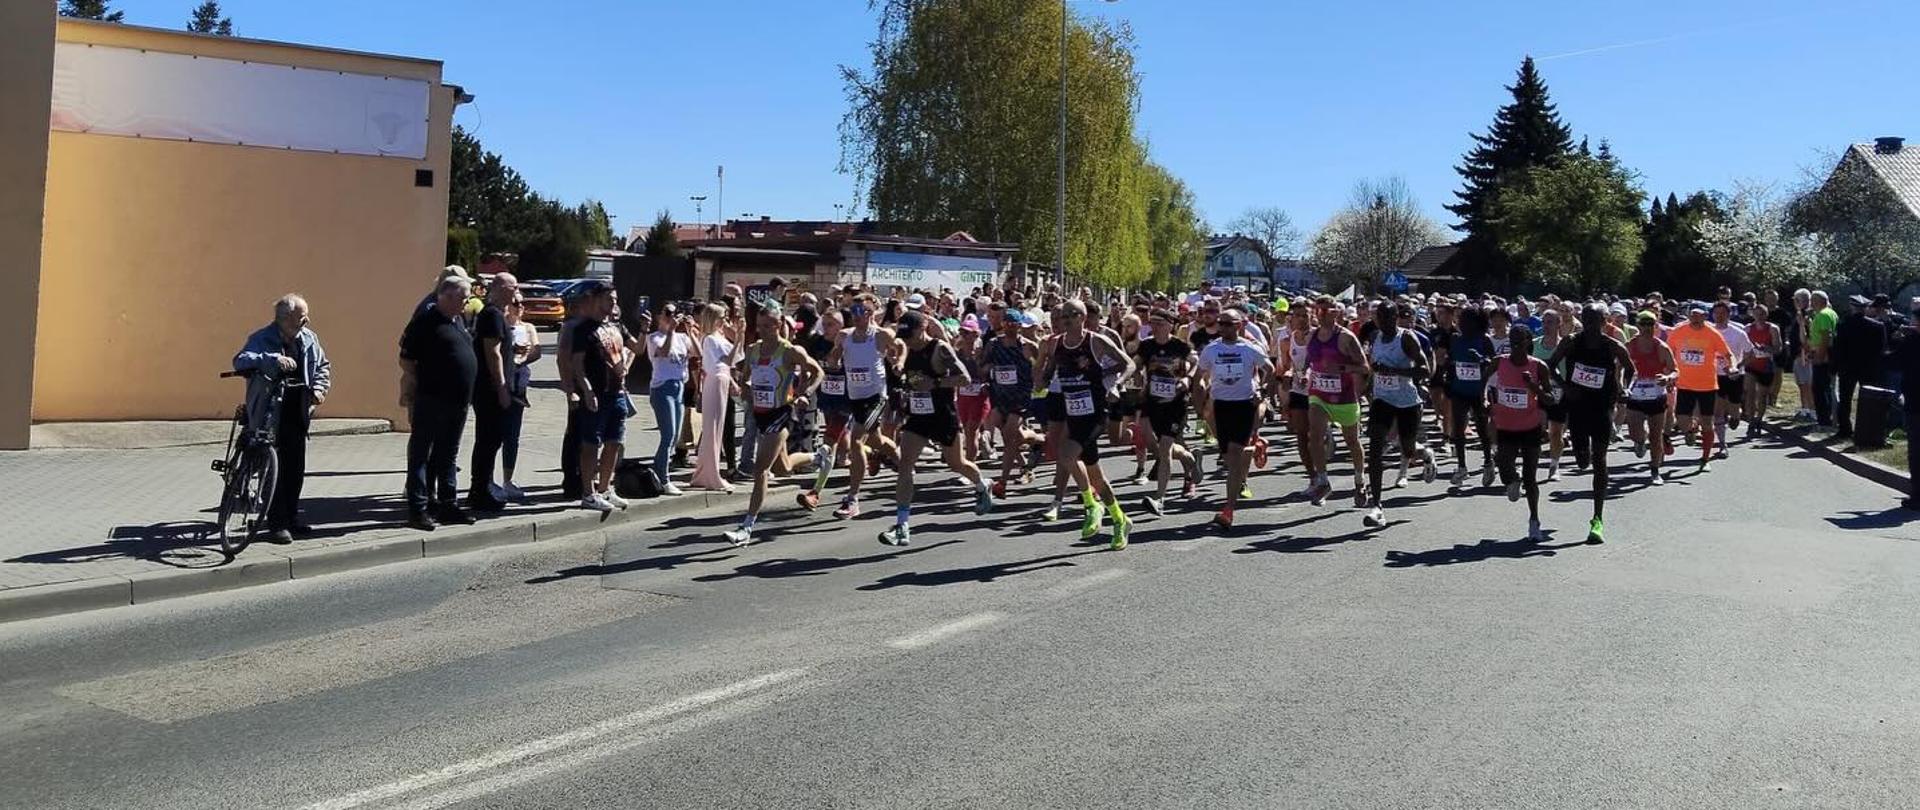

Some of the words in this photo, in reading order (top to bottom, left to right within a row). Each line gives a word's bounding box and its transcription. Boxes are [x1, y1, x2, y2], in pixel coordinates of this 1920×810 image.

[959, 272, 993, 283] GINTER
[1578, 372, 1599, 383] 164
[1069, 400, 1087, 410] 231
